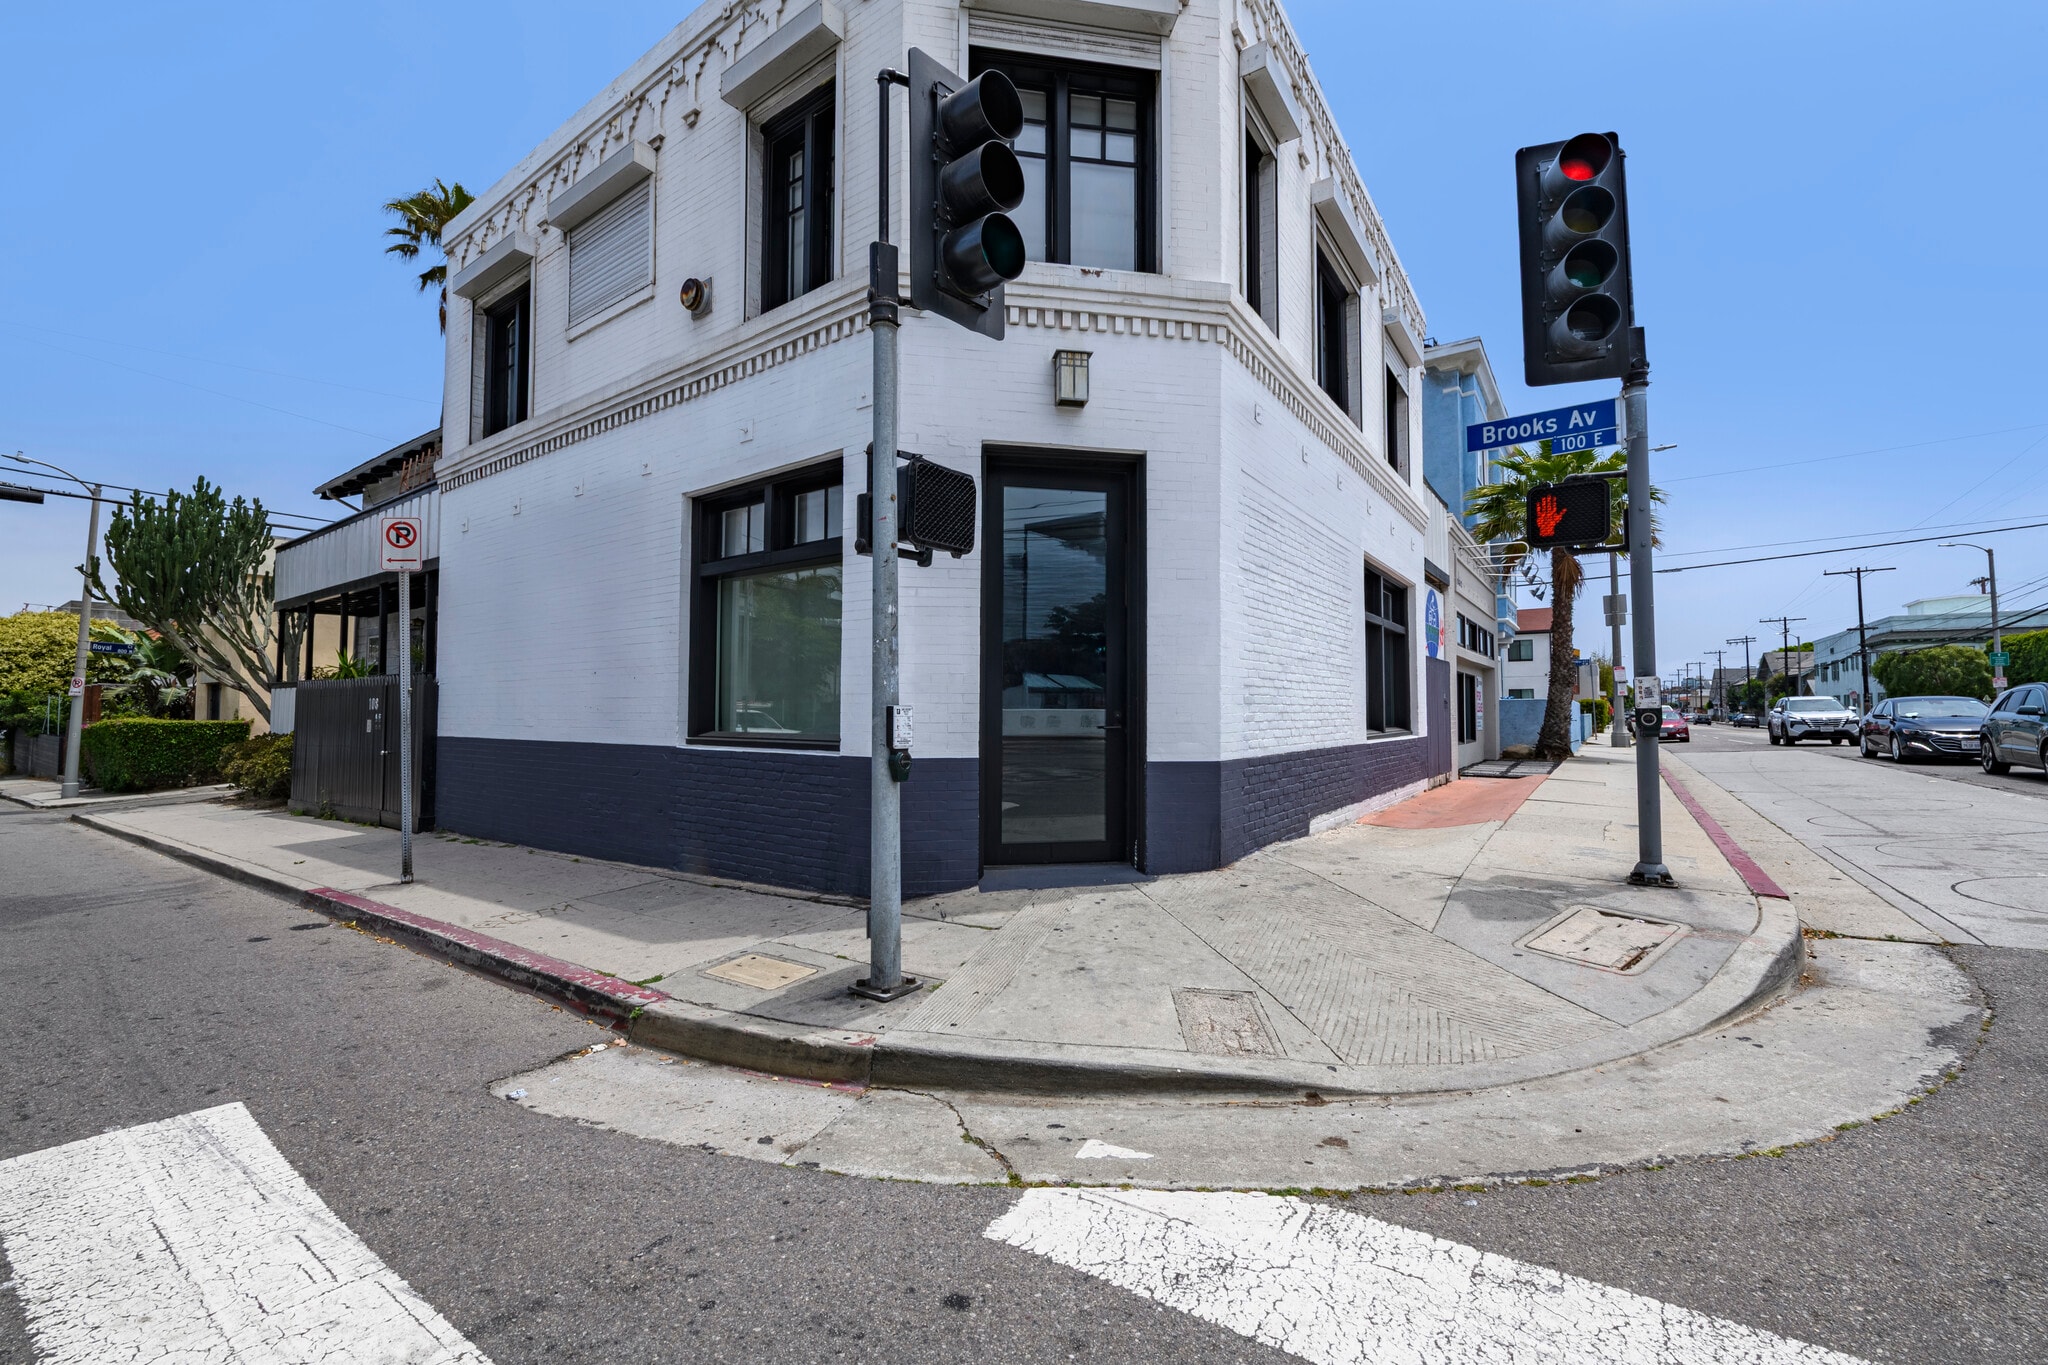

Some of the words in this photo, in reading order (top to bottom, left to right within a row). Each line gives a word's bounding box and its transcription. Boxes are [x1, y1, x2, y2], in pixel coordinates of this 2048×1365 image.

[1482, 416, 1558, 445] Brooks
[1569, 410, 1596, 429] Av
[1560, 435, 1586, 451] 100
[1594, 432, 1603, 446] E
[92, 643, 112, 652] Royal
